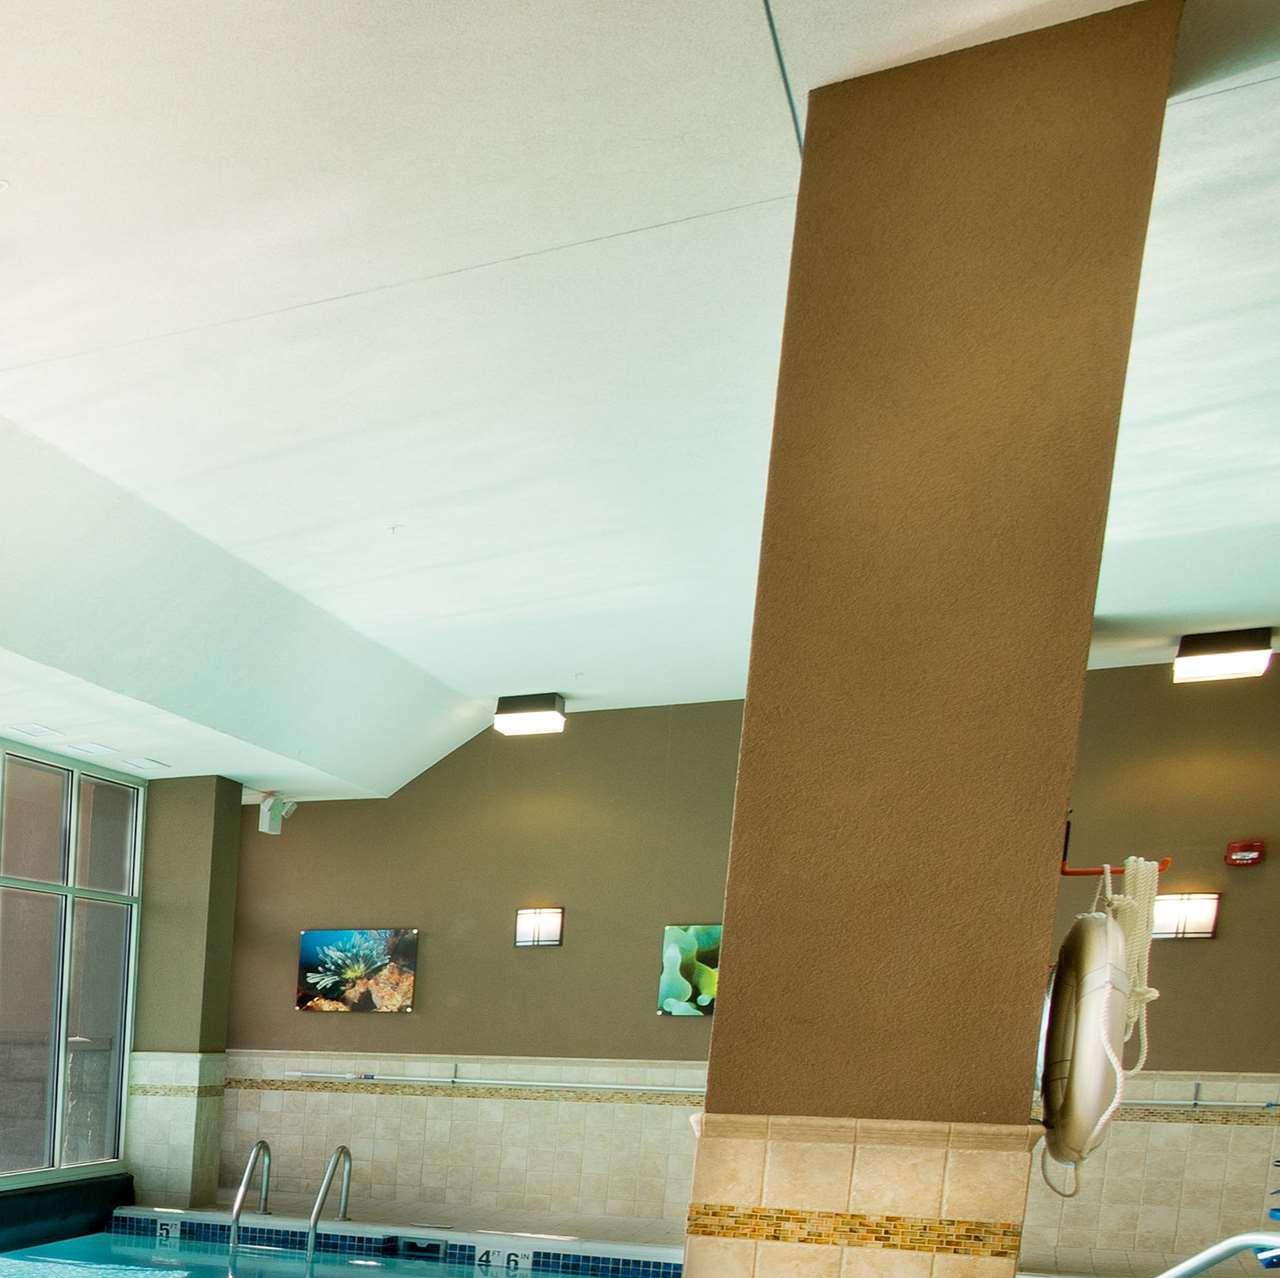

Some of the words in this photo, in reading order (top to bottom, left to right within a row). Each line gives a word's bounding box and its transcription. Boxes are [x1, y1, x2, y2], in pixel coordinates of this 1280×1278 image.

[159, 1222, 170, 1238] 5
[478, 1249, 492, 1264] 4
[506, 1252, 520, 1267] 6
